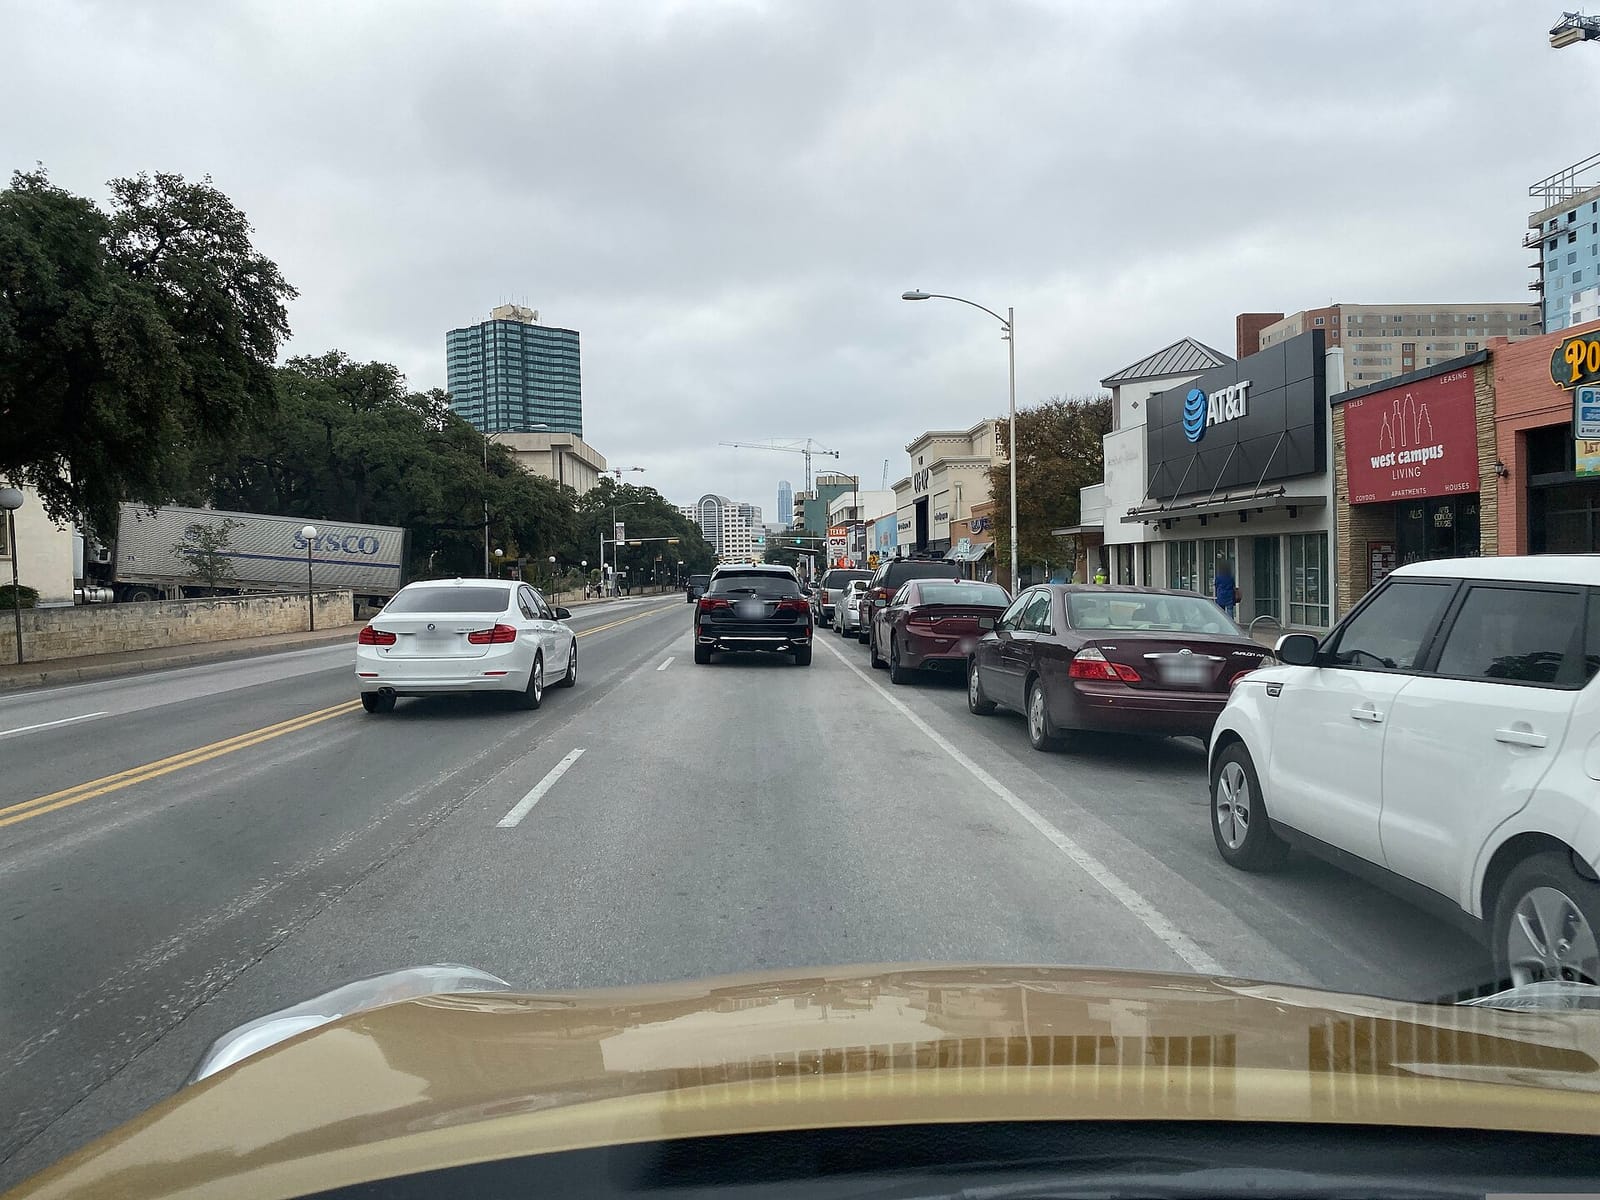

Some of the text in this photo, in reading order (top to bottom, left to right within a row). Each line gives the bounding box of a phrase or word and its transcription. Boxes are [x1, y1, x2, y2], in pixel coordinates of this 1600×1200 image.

[1440, 371, 1468, 385] LEASING
[1206, 380, 1252, 427] AT&T
[1348, 399, 1364, 409] SALES
[1370, 444, 1444, 469] west campus
[1391, 466, 1422, 481] LIVING
[1391, 487, 1427, 497] APARTMENTS
[1444, 482, 1470, 492] HOUSES
[1355, 493, 1376, 502] CONDOS
[829, 528, 847, 536] TEXAS
[293, 530, 380, 555] SYSCO
[829, 538, 847, 546] CVS
